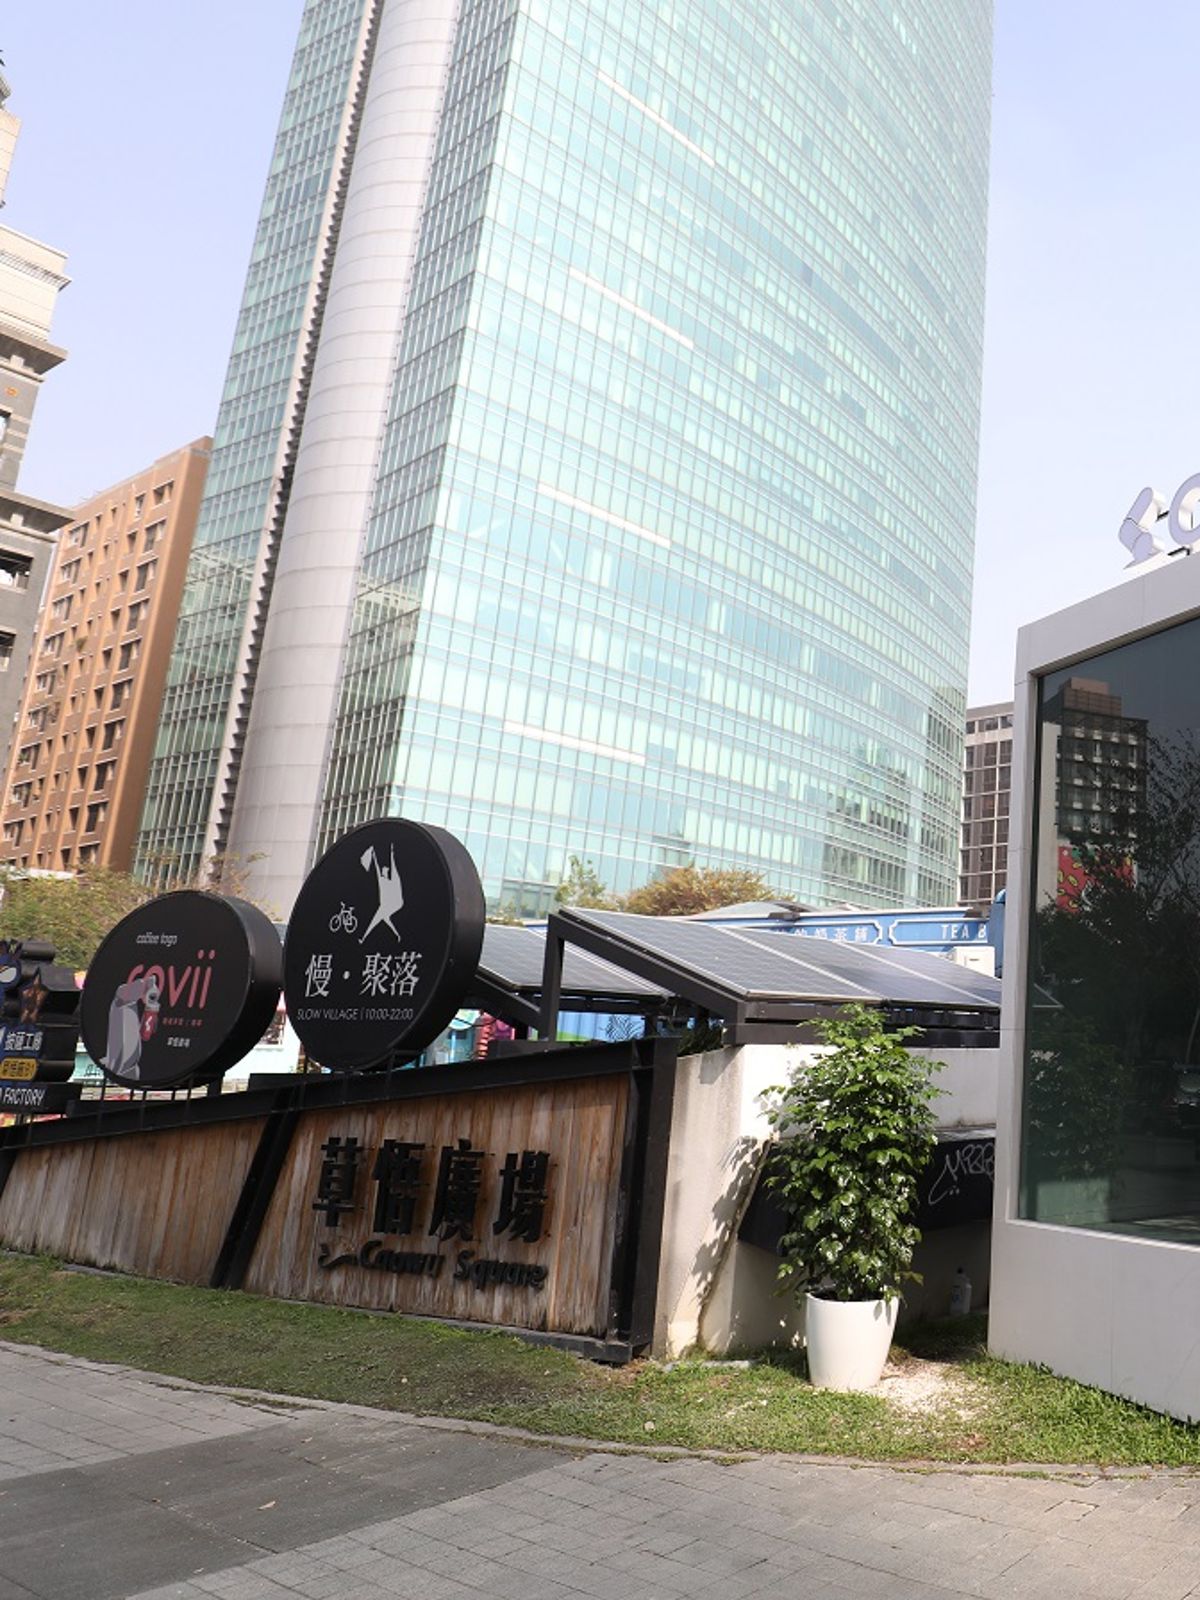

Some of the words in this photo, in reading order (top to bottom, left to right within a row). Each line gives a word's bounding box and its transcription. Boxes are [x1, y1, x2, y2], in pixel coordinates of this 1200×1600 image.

[135, 931, 160, 945] coffee
[940, 923, 969, 940] TEA
[297, 1008, 321, 1021] SLOW
[322, 1008, 359, 1021] VILLAGE
[3, 1087, 47, 1106] FACTORY
[312, 1137, 550, 1243] 草悟廣場
[453, 1250, 548, 1290] Square
